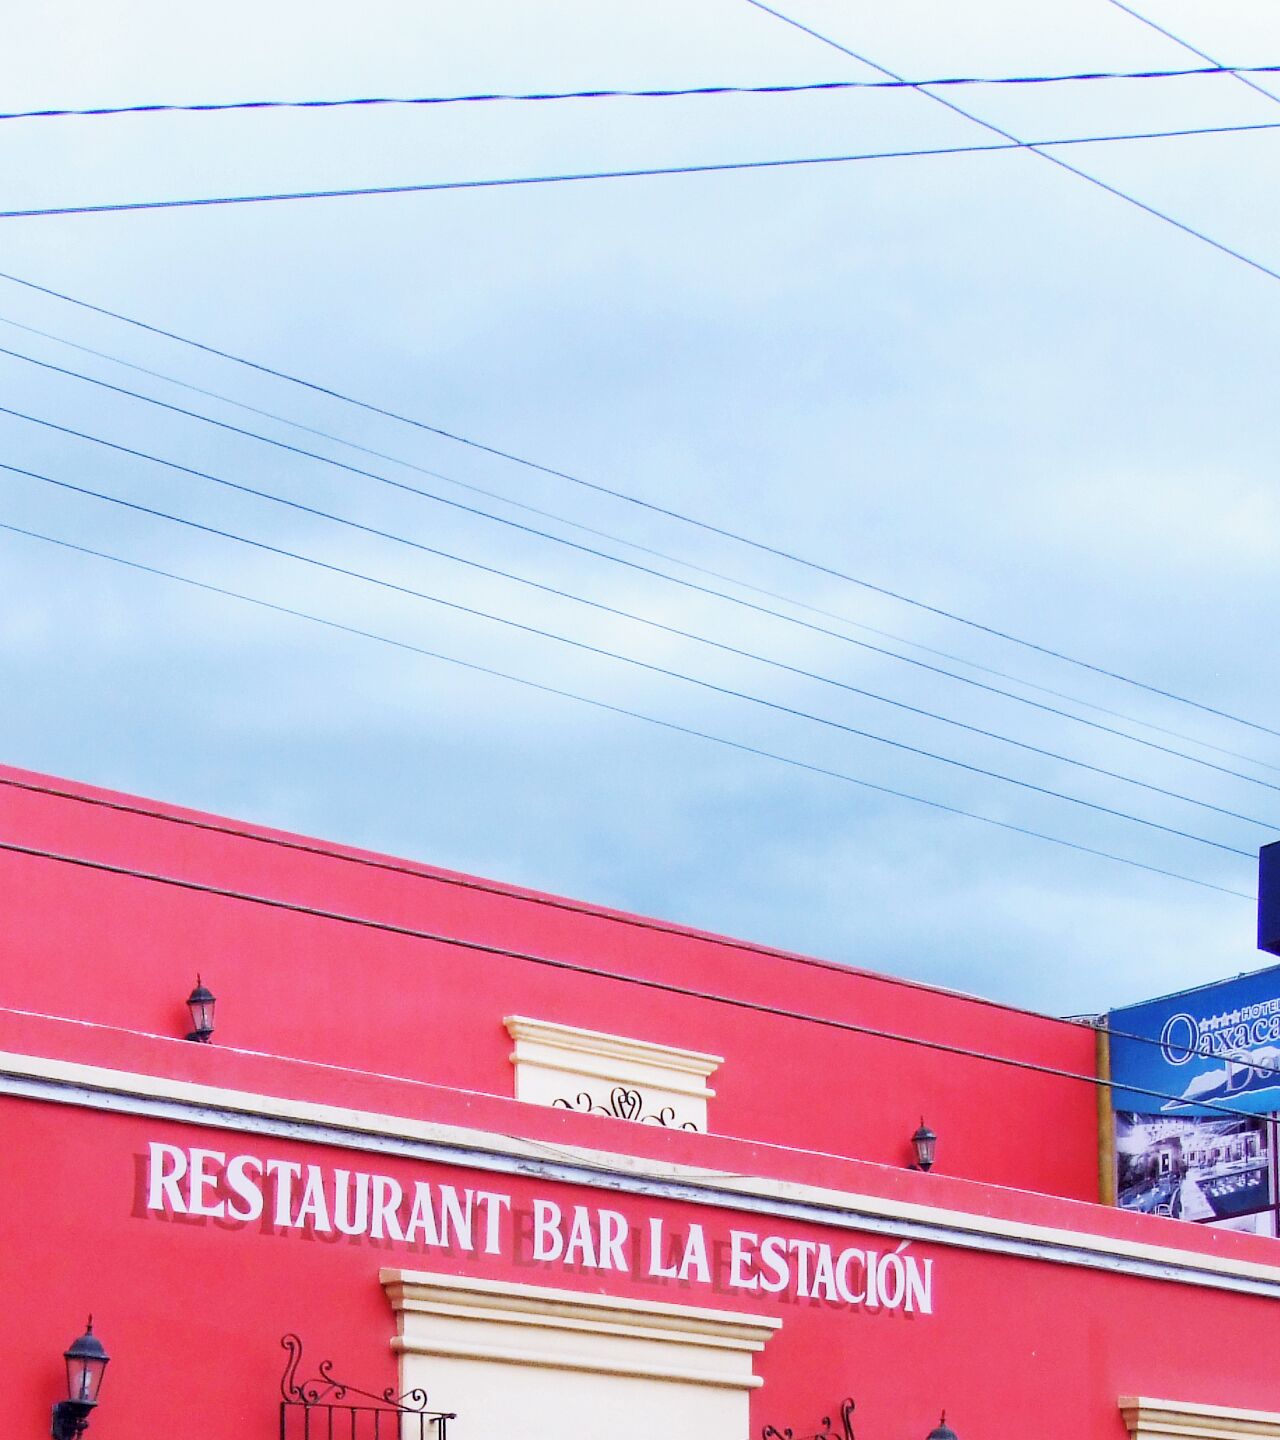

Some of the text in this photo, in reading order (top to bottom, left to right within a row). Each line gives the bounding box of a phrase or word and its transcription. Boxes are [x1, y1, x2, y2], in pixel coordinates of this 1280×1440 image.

[147, 1141, 934, 1314] RESTAURANT BAR LA ESTACIÓN
